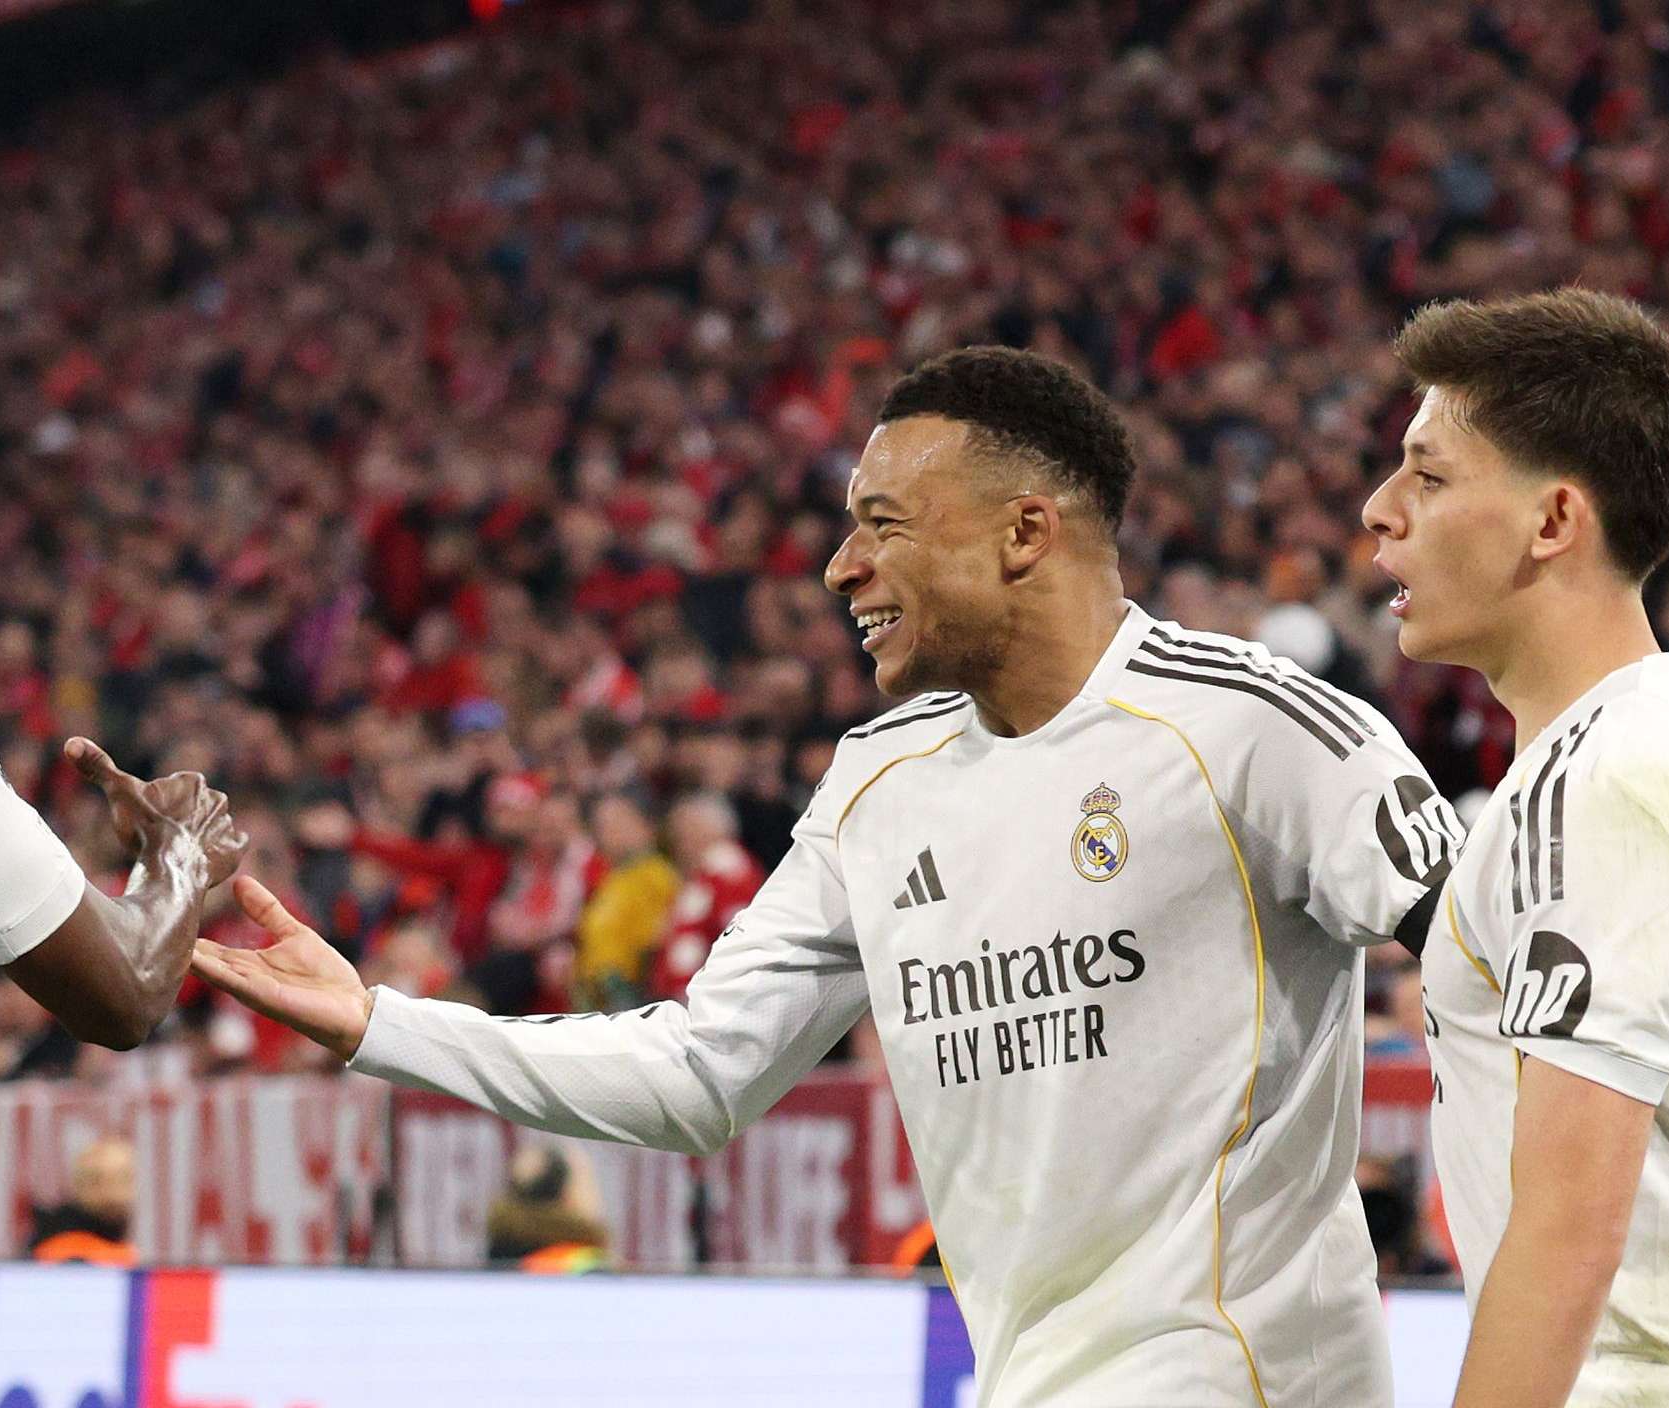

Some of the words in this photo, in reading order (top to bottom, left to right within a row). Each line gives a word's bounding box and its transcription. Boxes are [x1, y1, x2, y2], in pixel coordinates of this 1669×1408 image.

[1380, 777, 1468, 882] hp
[898, 929, 1146, 1026] Emirates
[1500, 932, 1589, 1038] hp
[935, 1026, 980, 1088] FLY
[994, 1004, 1108, 1075] BETTER
